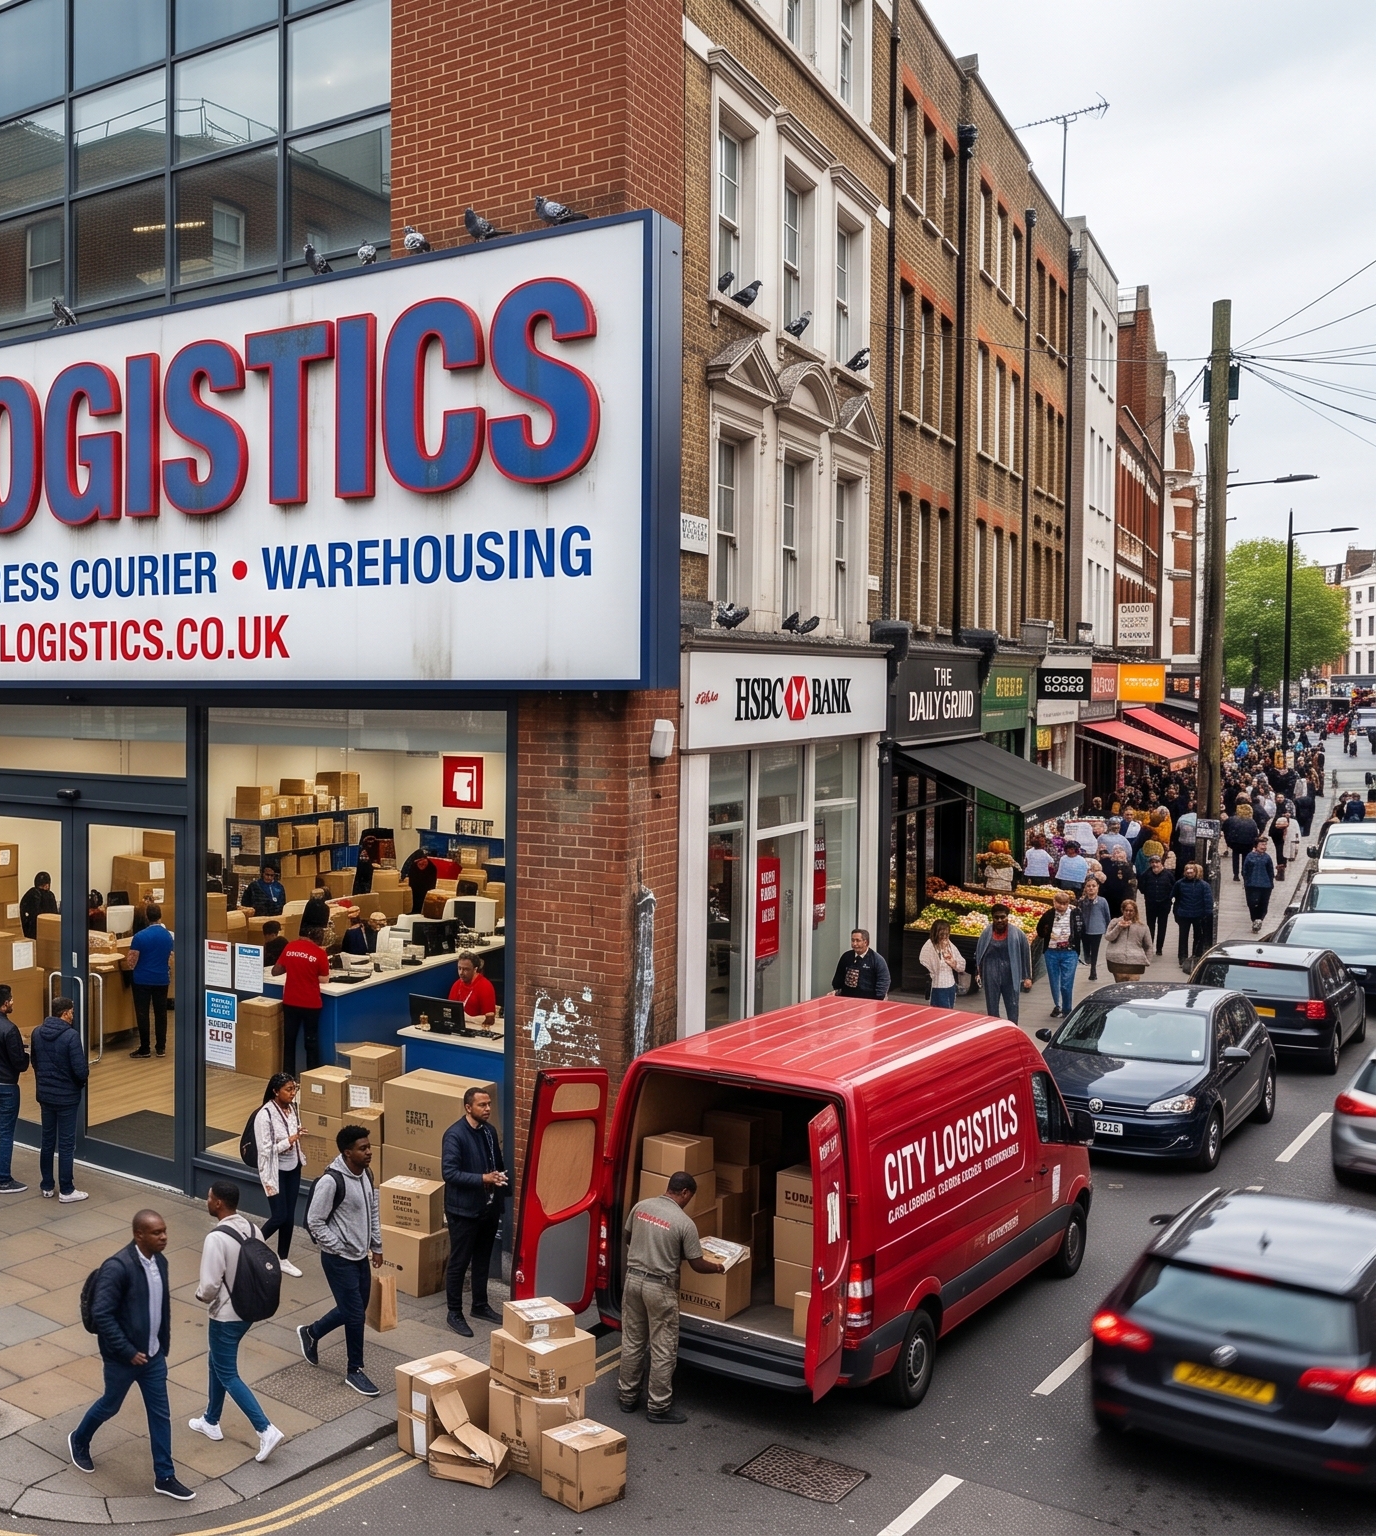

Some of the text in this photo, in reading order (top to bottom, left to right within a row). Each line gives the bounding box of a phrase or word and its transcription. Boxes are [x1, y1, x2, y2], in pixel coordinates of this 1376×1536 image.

[70, 551, 217, 599] COURIER
[262, 525, 592, 590] WAREHOUSING
[934, 667, 952, 686] THE
[735, 677, 852, 721] HSBC BANK
[909, 691, 942, 722] DAILY
[884, 1137, 927, 1200] CITY
[932, 1093, 1019, 1176] LOGISTICS
